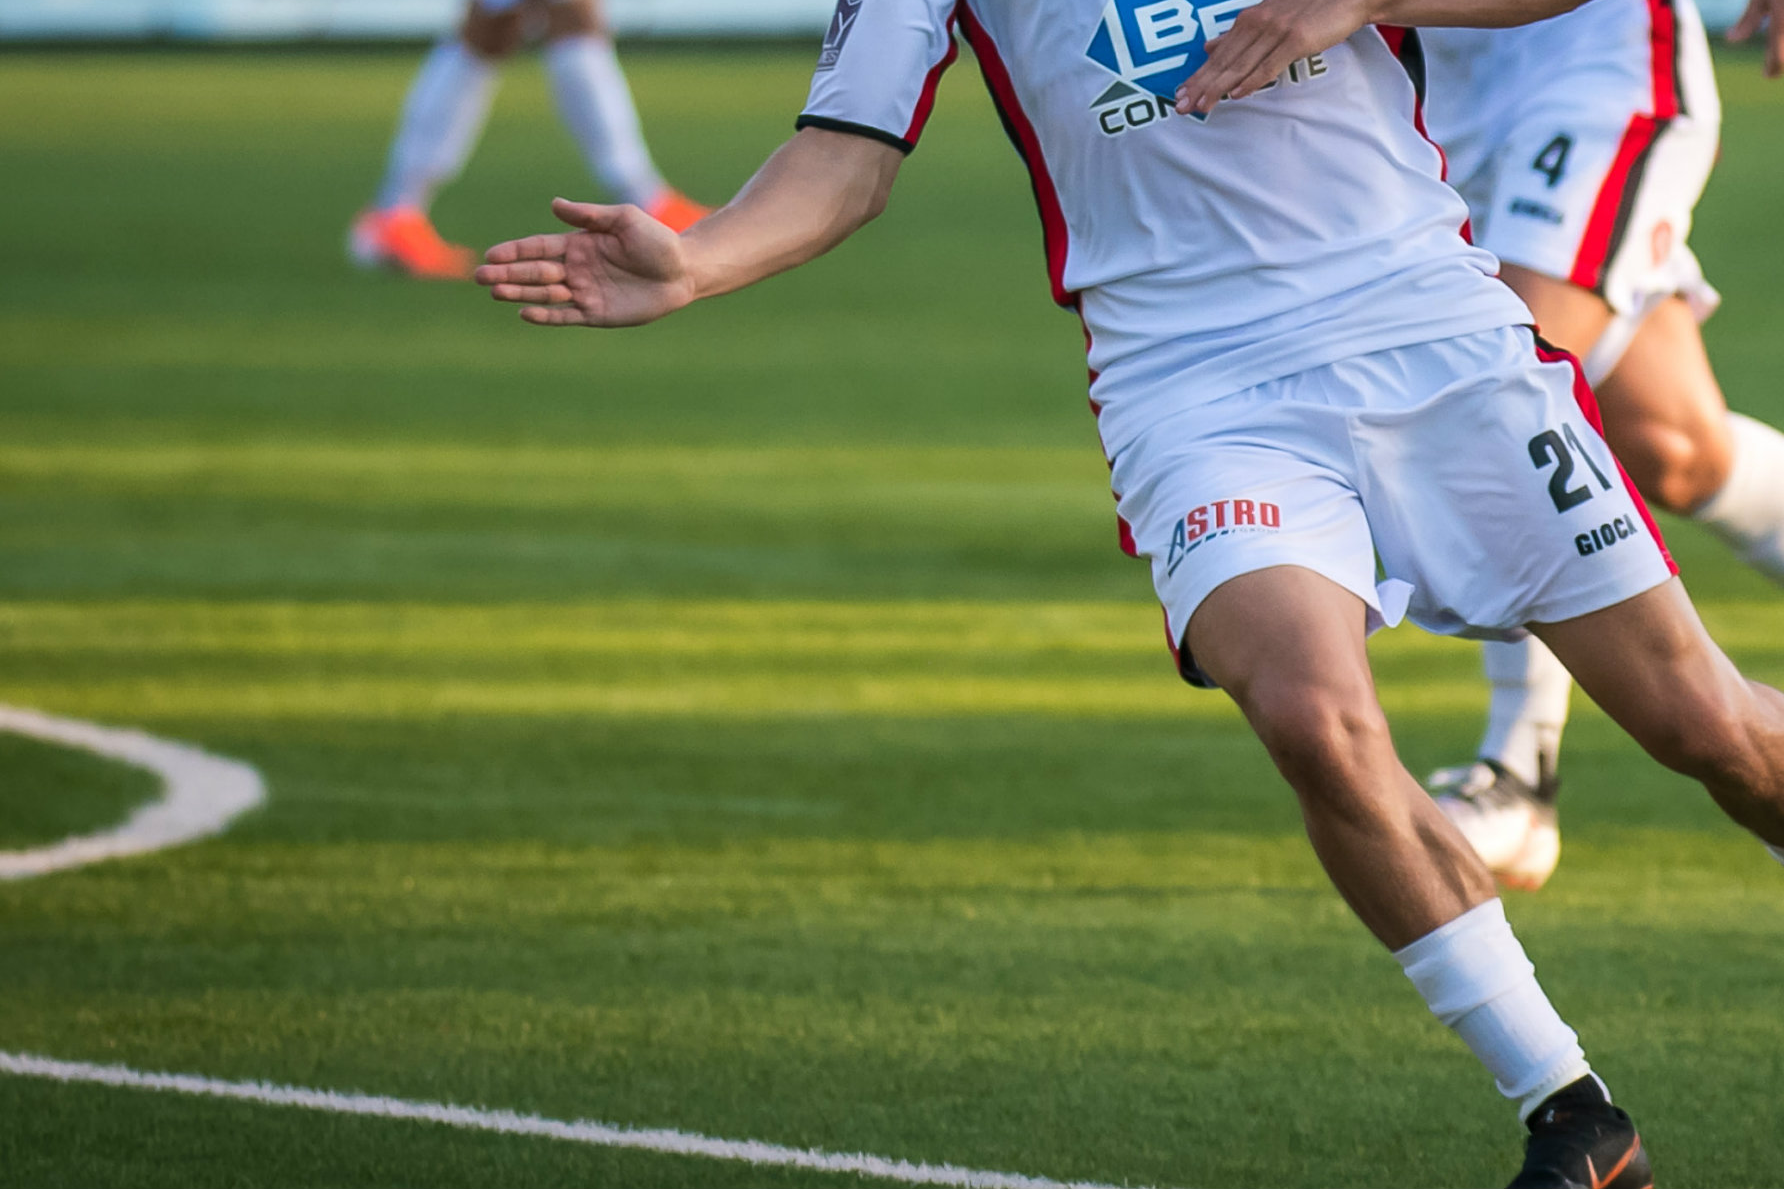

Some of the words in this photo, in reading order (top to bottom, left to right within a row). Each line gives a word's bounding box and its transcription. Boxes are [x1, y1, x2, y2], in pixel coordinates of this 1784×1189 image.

[1532, 135, 1572, 188] 4
[1527, 422, 1613, 515] 21
[1167, 498, 1281, 567] ASTRO
